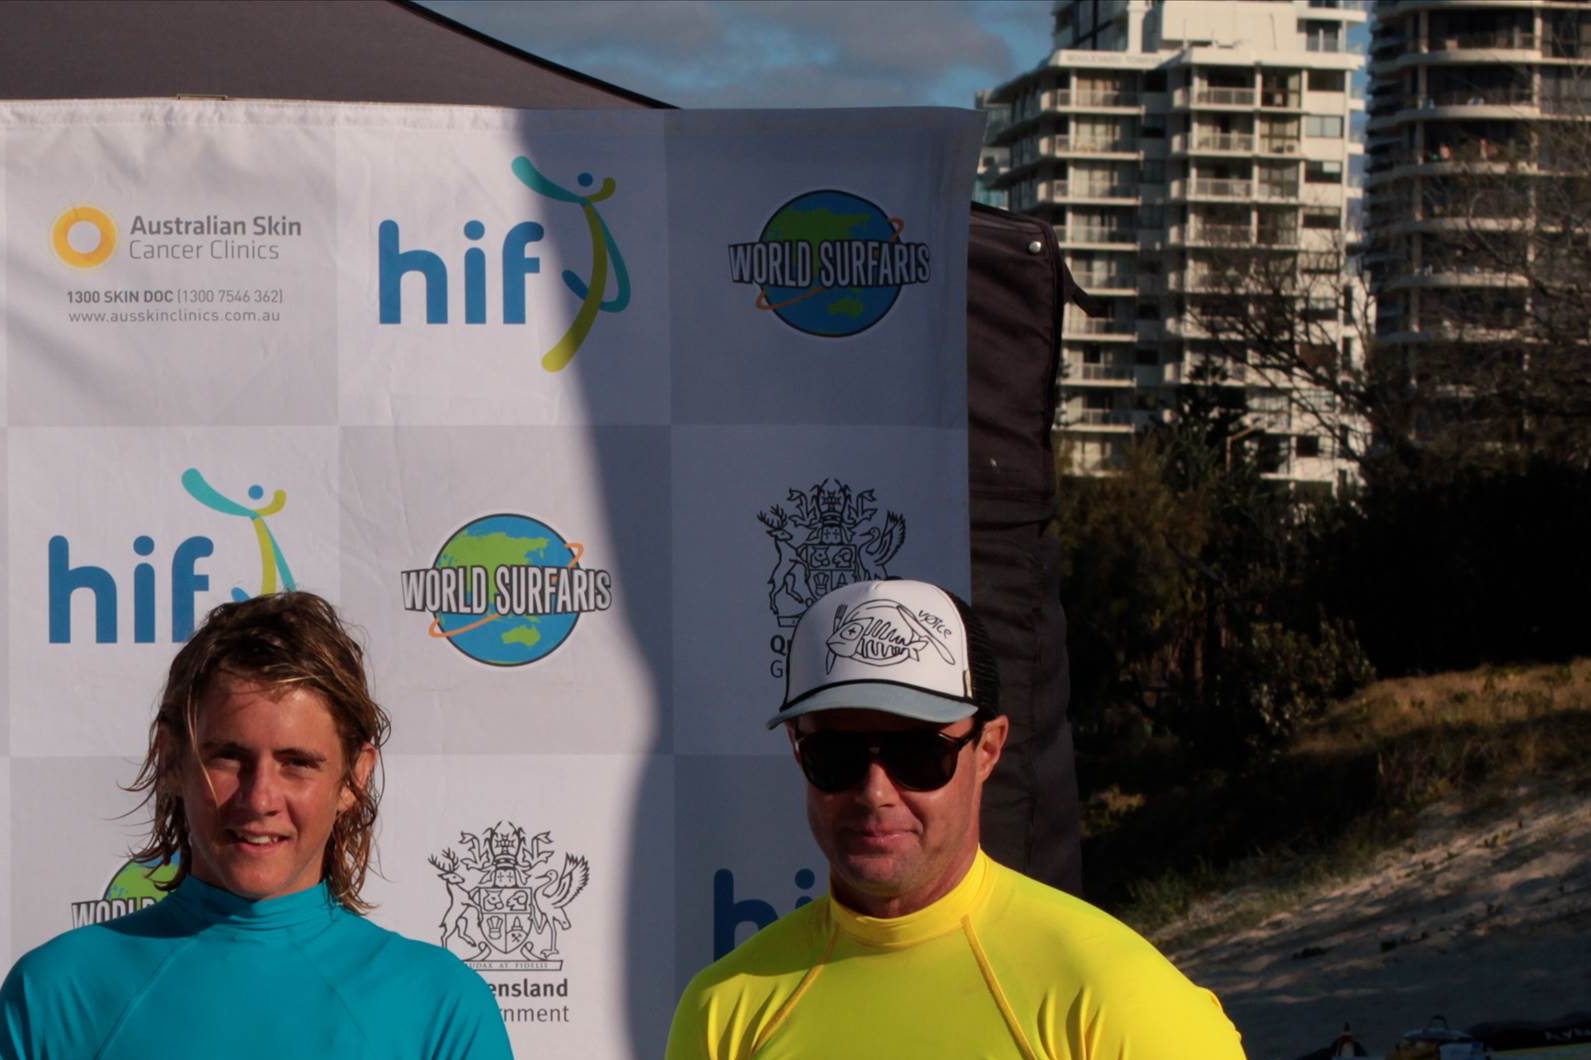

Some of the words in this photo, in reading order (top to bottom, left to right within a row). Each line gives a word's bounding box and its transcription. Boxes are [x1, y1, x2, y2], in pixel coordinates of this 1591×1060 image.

[130, 214, 247, 236] Australian
[253, 215, 302, 236] Skin
[129, 239, 203, 260] Cancer
[209, 239, 280, 260] Clinics
[728, 240, 812, 286] WORLD
[819, 240, 931, 287] SURFARIS
[378, 219, 544, 324] hif
[66, 290, 100, 303] 1300
[103, 289, 139, 303] SKIN
[143, 289, 174, 303] DOC
[220, 289, 252, 304] 7546
[68, 308, 280, 323] www.ausskinclinics.com.au
[48, 535, 214, 644] hif
[401, 567, 488, 615] WORLD
[494, 567, 612, 615] SURFARIS
